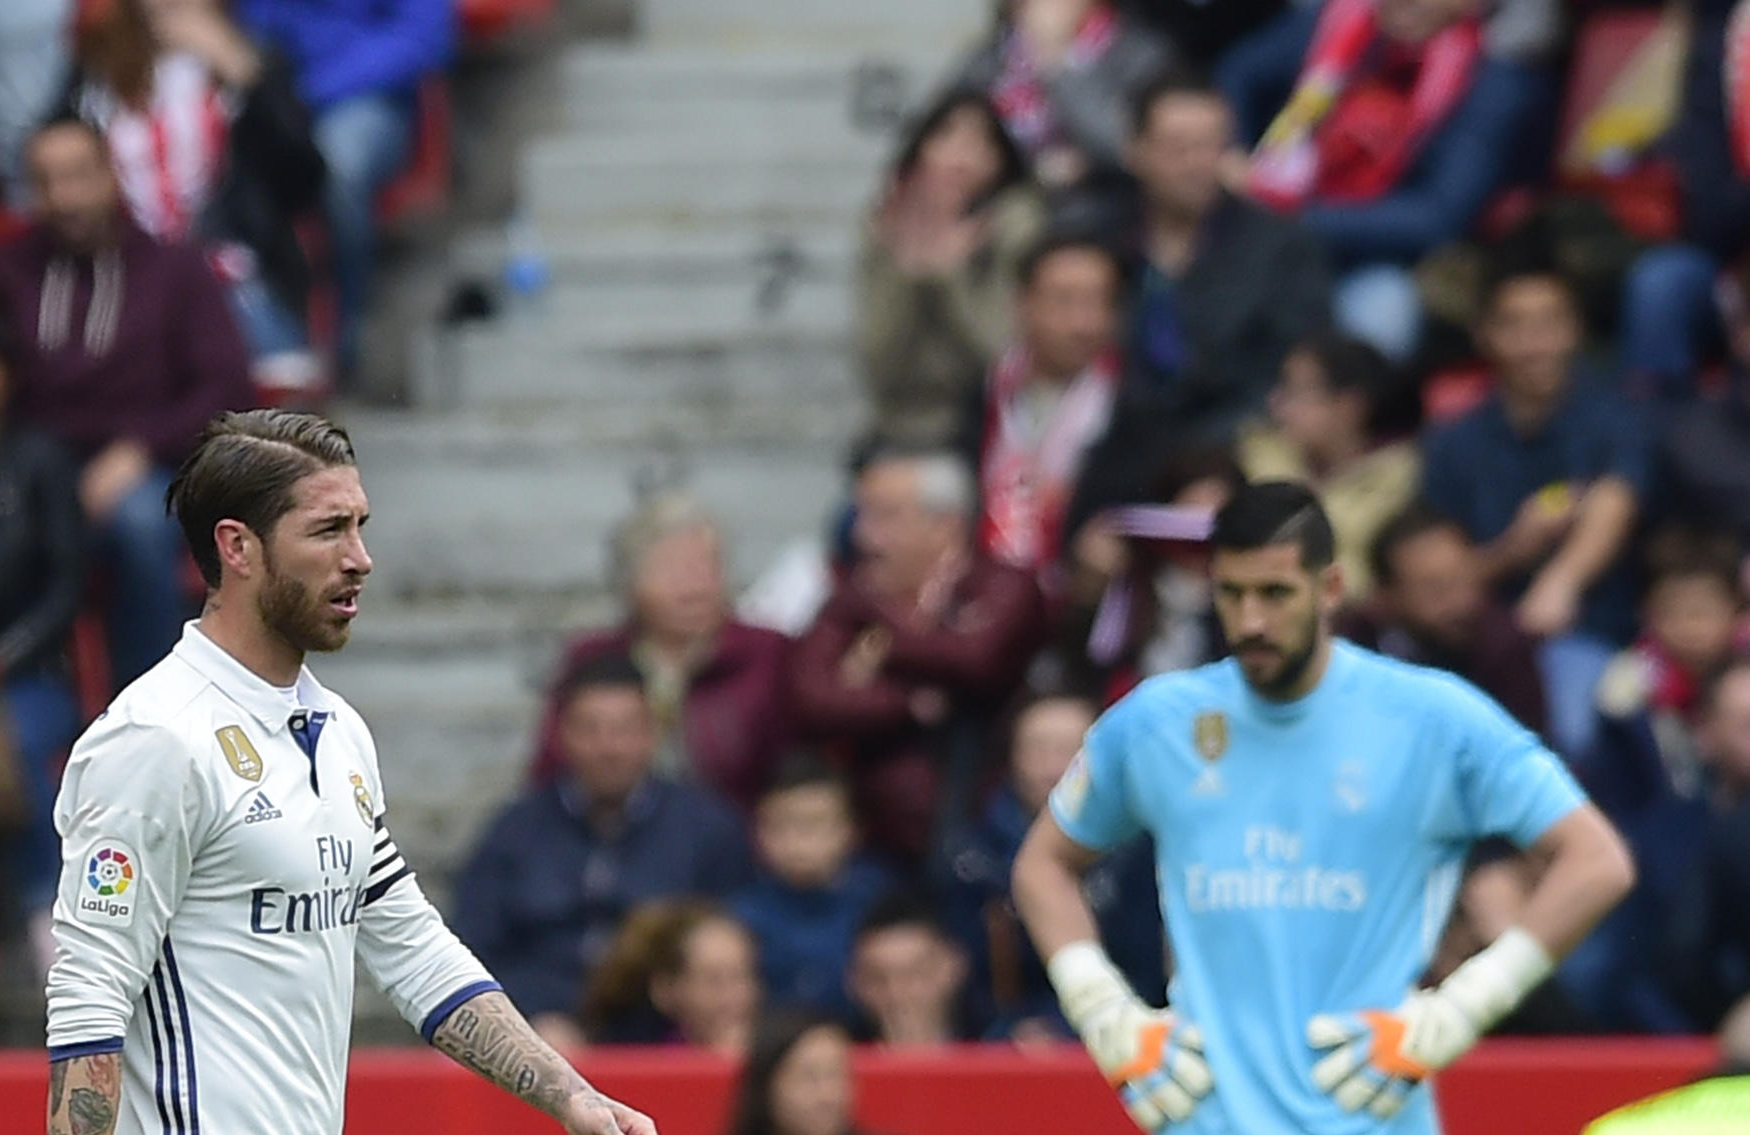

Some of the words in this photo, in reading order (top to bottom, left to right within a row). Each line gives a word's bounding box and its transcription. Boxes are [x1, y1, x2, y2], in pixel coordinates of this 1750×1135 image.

[316, 834, 352, 876] Fly
[81, 897, 130, 917] LaLiga
[1186, 864, 1367, 912] Emirates
